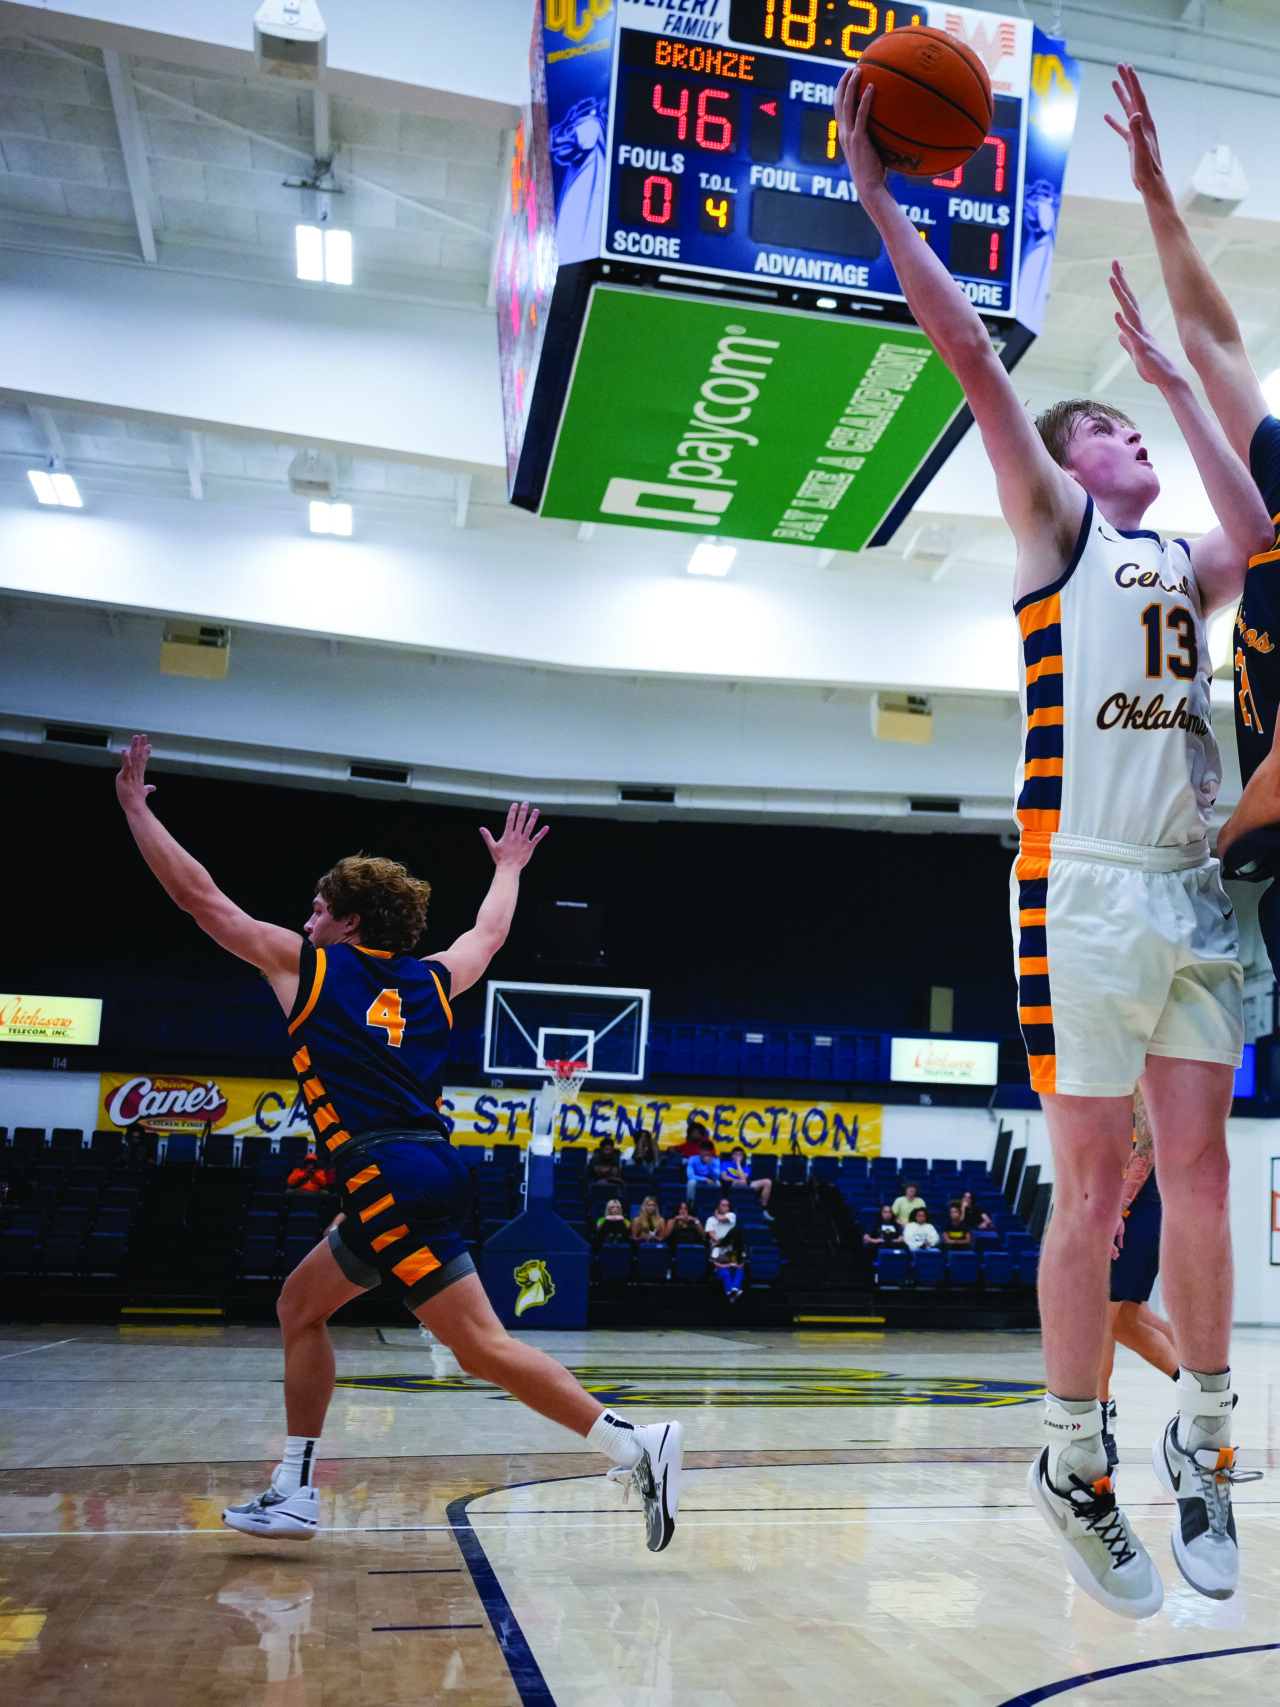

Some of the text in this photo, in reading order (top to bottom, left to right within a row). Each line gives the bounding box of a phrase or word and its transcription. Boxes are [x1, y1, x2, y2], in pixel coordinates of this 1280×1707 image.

[663, 13, 723, 39] FAMILY
[765, 0, 920, 59] 18:2
[655, 40, 755, 81] BRONZE
[789, 79, 836, 106] PERI
[652, 84, 732, 152] 46
[826, 119, 837, 160] 1
[618, 144, 685, 175] FOULS
[642, 175, 673, 224] 0
[698, 172, 738, 194] T.O.L.
[750, 165, 861, 202] FOUL PLAY
[705, 198, 728, 228] 4
[948, 197, 1010, 226] FOULS
[613, 229, 681, 259] SCORE
[989, 232, 999, 271] 1
[754, 251, 869, 287] ADVANTAGE
[816, 456, 866, 471] A
[1141, 602, 1198, 682] 13
[366, 988, 407, 1049] 4
[109, 1077, 228, 1126] Cane's
